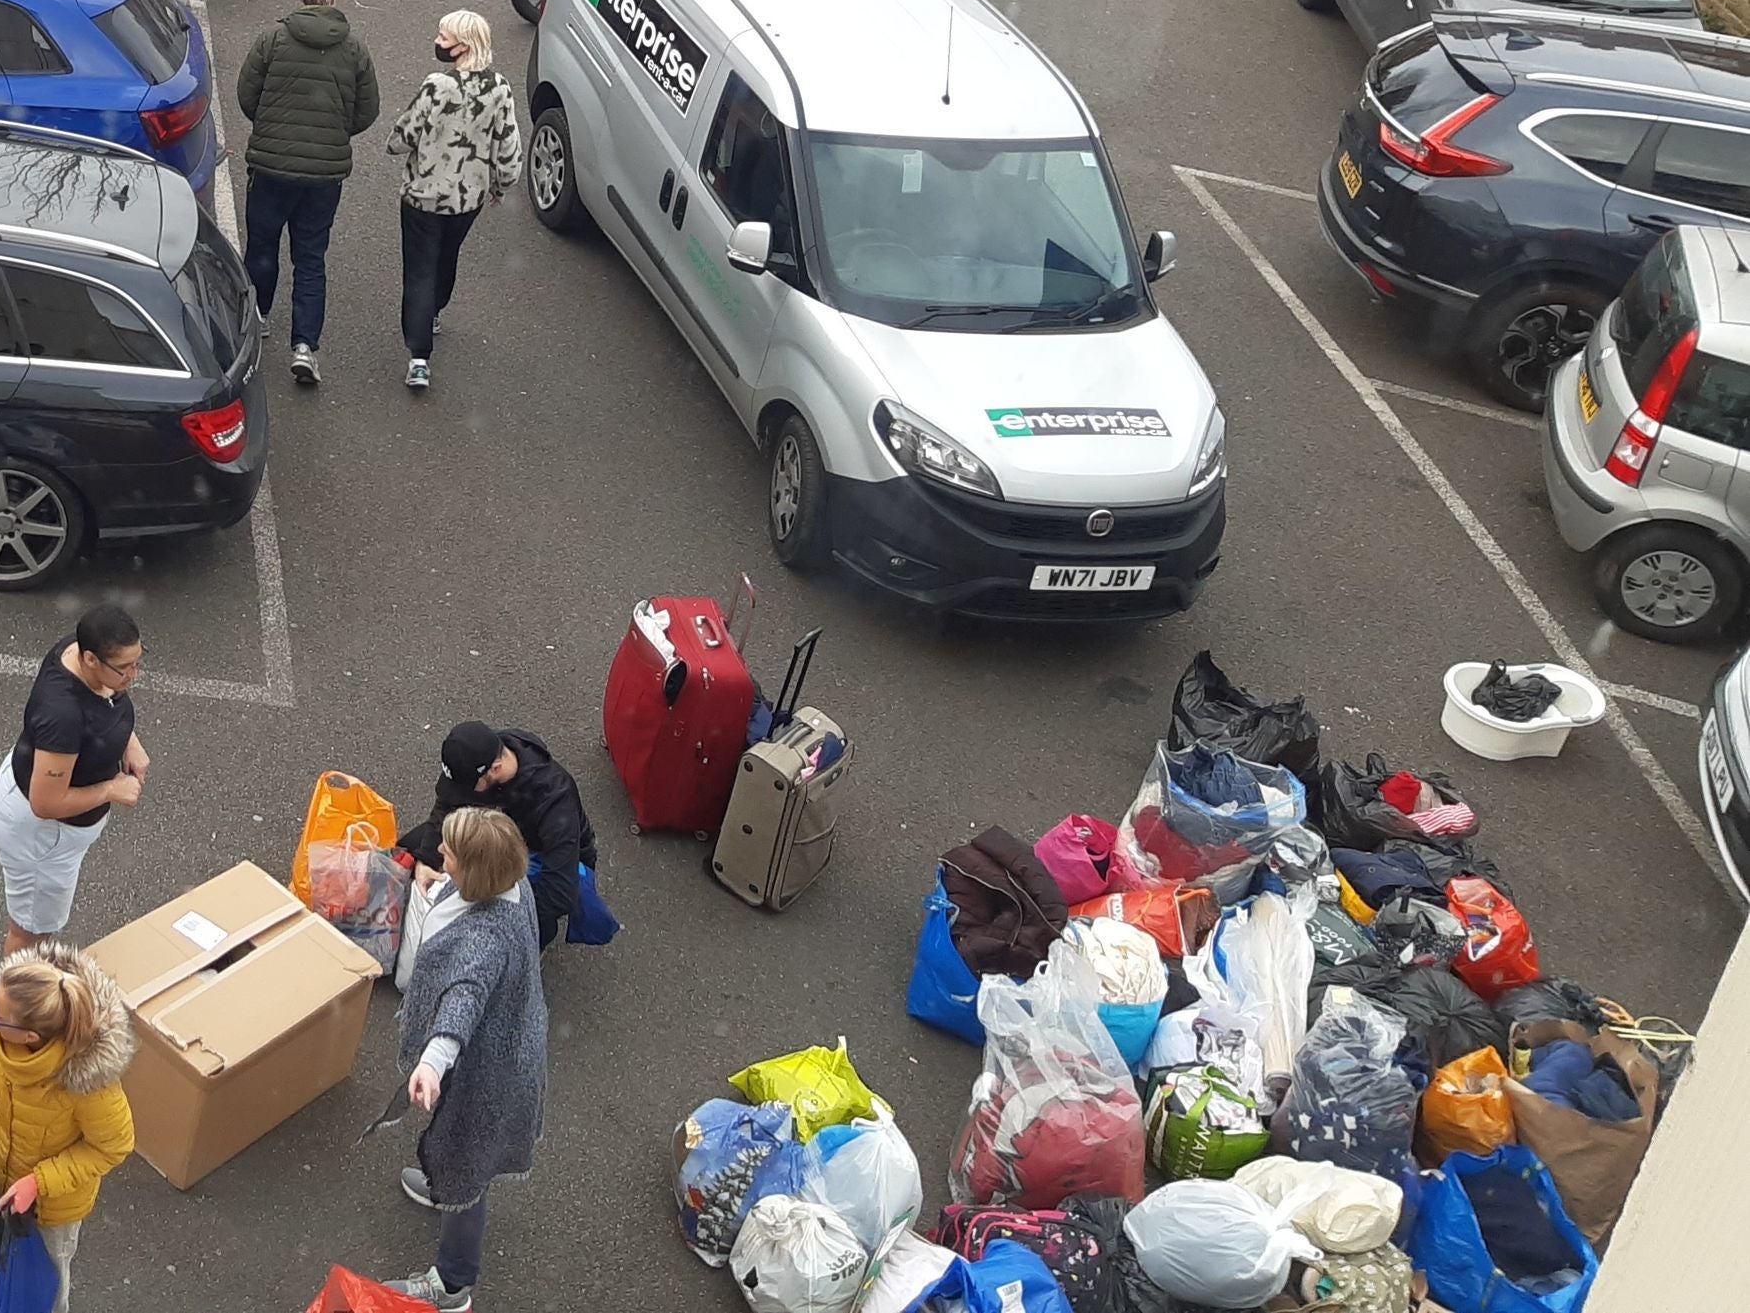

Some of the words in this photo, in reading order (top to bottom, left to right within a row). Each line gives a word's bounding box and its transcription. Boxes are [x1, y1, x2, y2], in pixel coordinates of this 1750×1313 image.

[641, 53, 688, 107] rent-a-car
[996, 410, 1164, 431] enterprise
[1110, 427, 1169, 436] rent-a-car
[1047, 567, 1096, 588] WN71
[1100, 568, 1143, 588] JBV
[325, 904, 400, 926] TESCO
